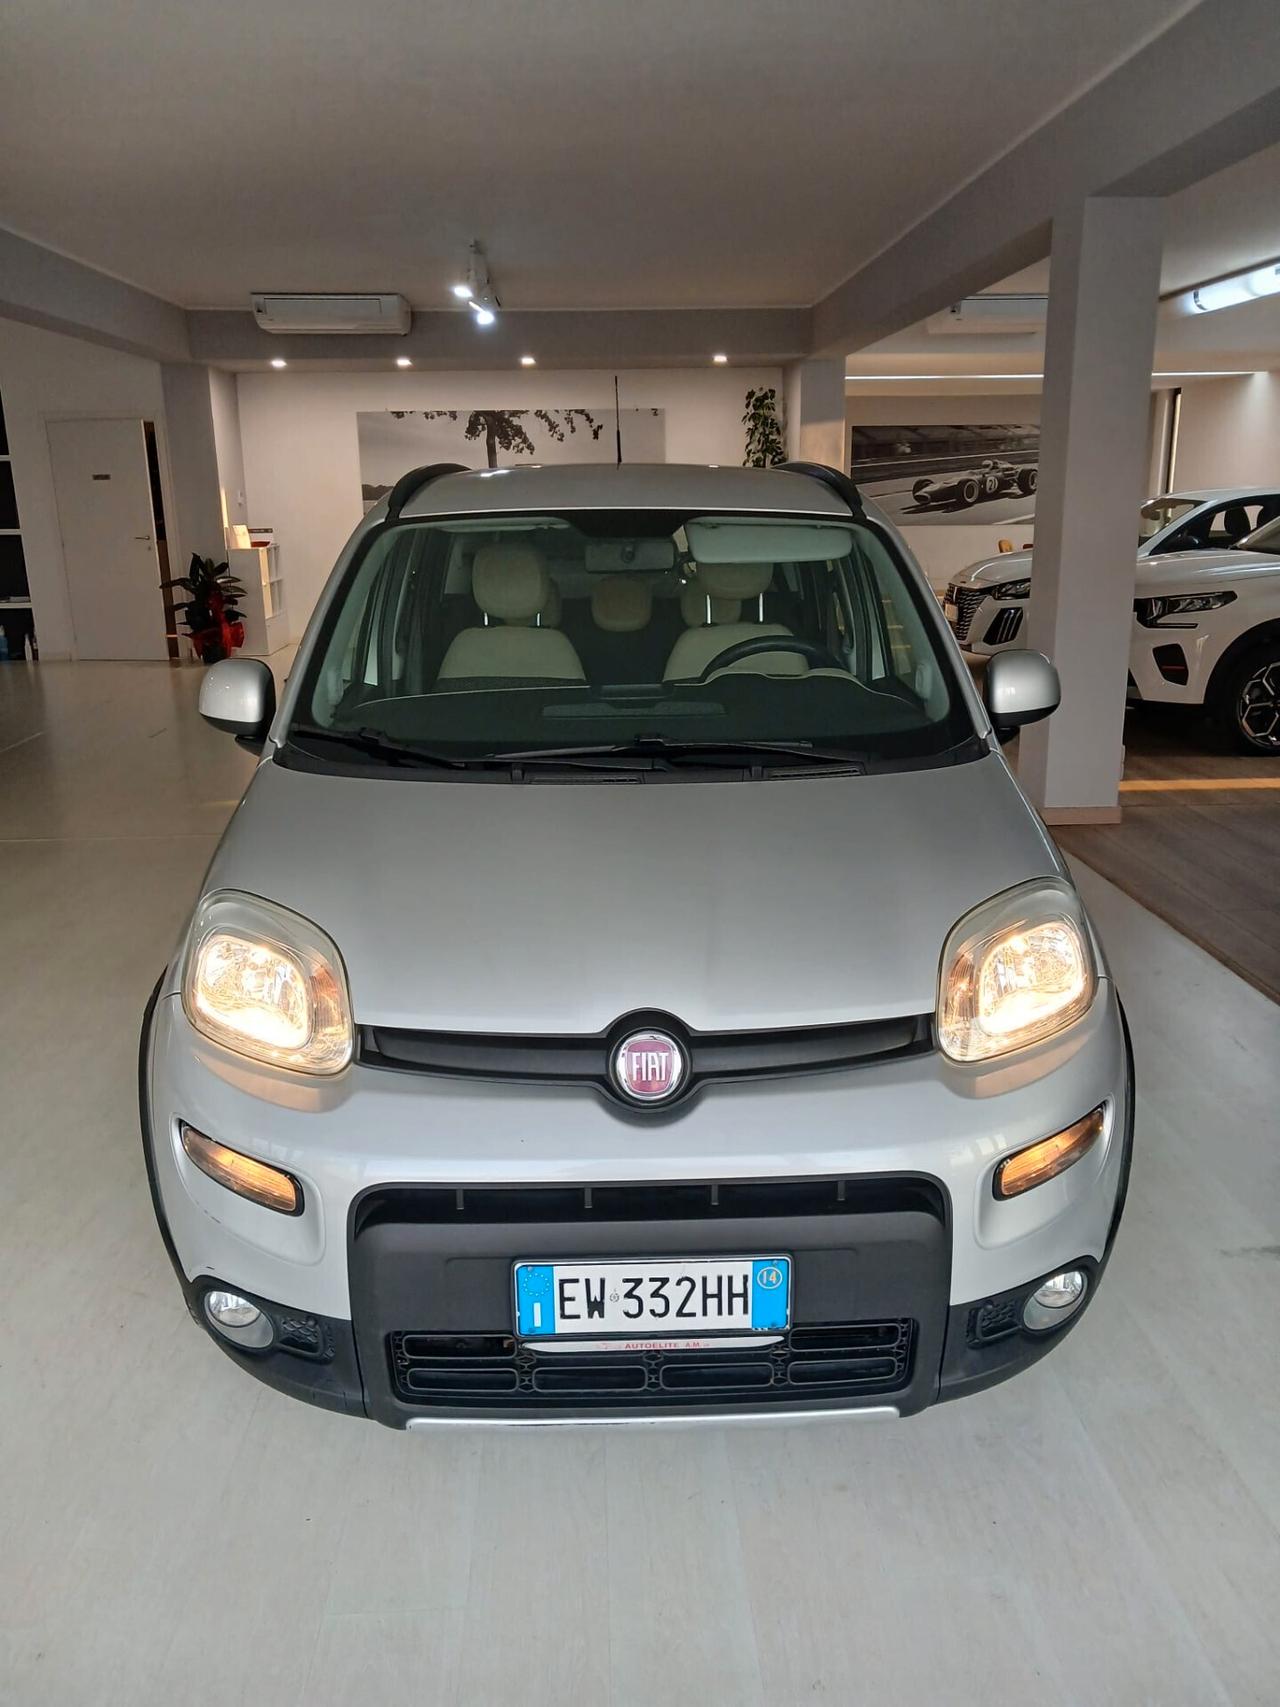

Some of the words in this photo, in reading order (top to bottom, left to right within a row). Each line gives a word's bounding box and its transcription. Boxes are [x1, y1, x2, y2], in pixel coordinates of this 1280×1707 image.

[632, 1052, 669, 1081] FIAT
[762, 1270, 776, 1285] 14
[558, 1278, 605, 1319] EW
[622, 1274, 748, 1319] 332HH
[533, 1302, 541, 1328] I
[624, 1342, 678, 1350] AUTOELITE
